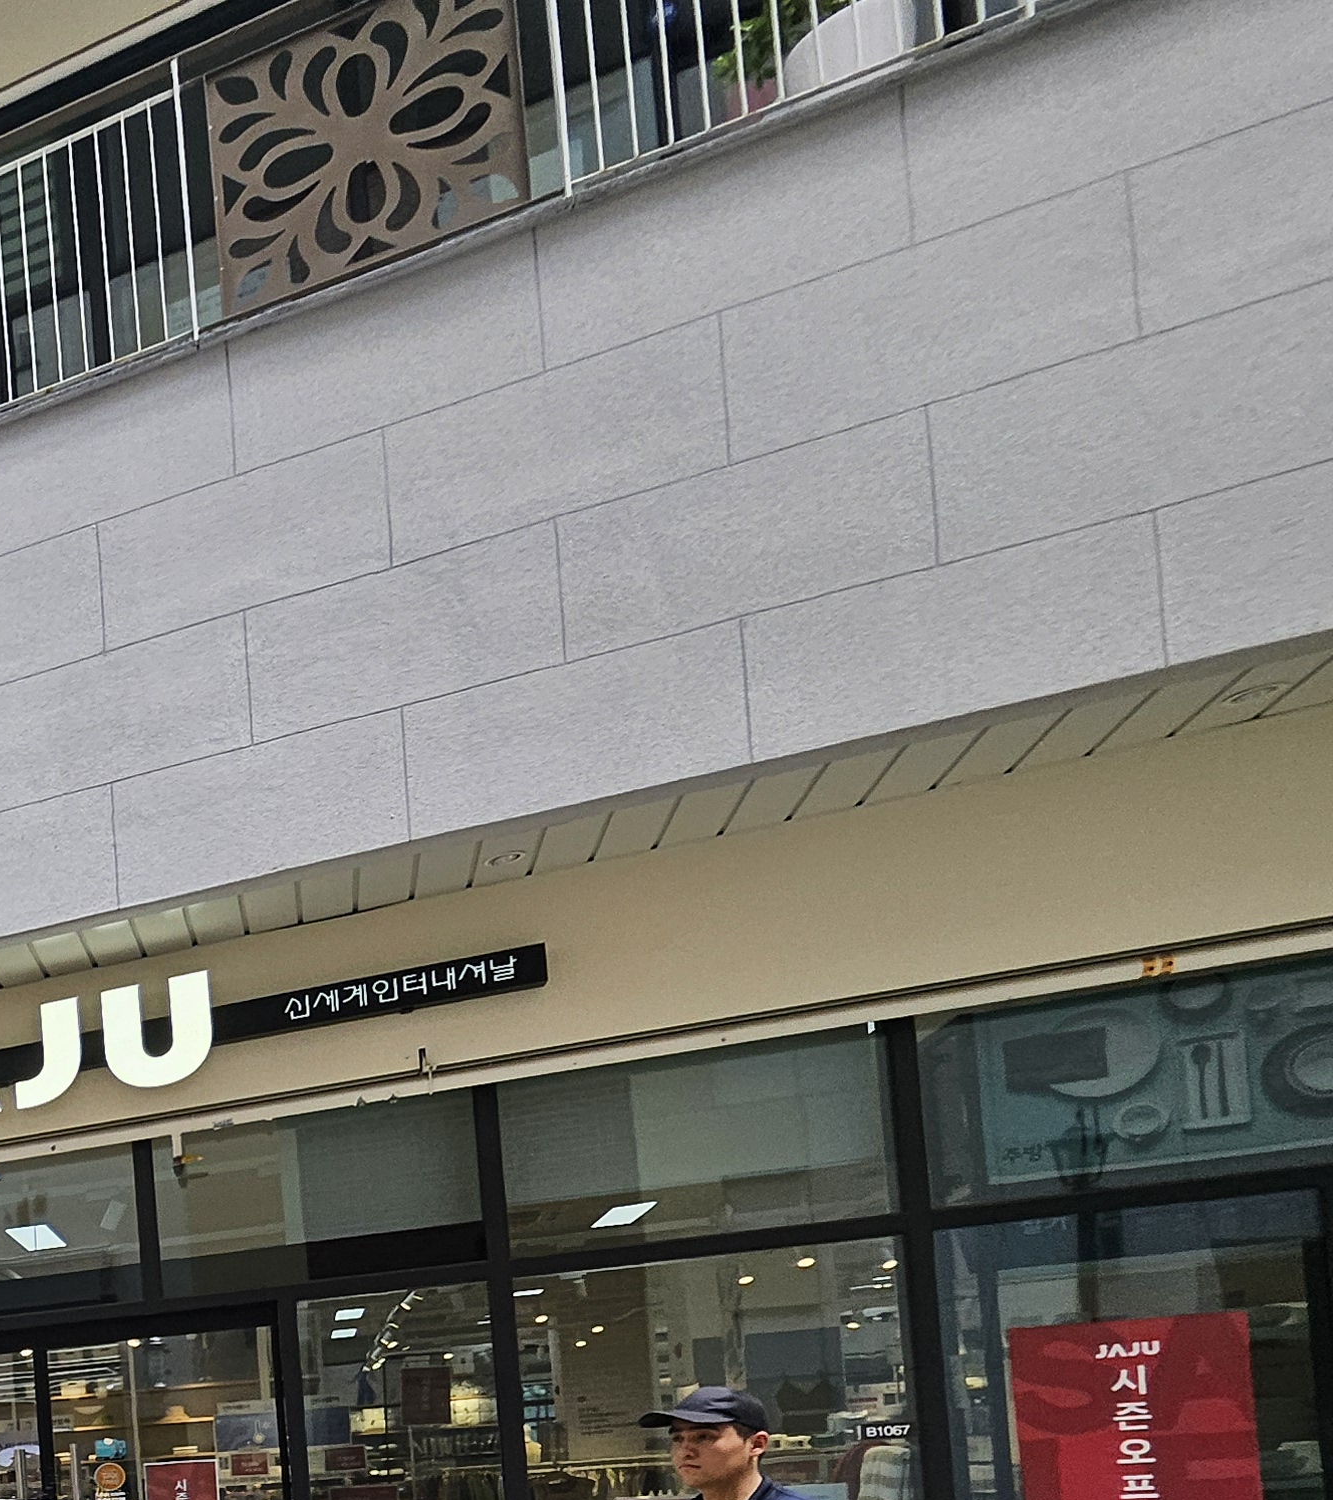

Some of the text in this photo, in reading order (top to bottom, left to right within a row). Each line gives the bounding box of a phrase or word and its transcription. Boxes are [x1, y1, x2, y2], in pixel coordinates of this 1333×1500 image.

[283, 954, 518, 1021] 신세계인터내셔날
[1095, 1340, 1161, 1360] JAJU
[865, 1424, 911, 1438] B1067
[1110, 1364, 1161, 1500] 시즌오프
